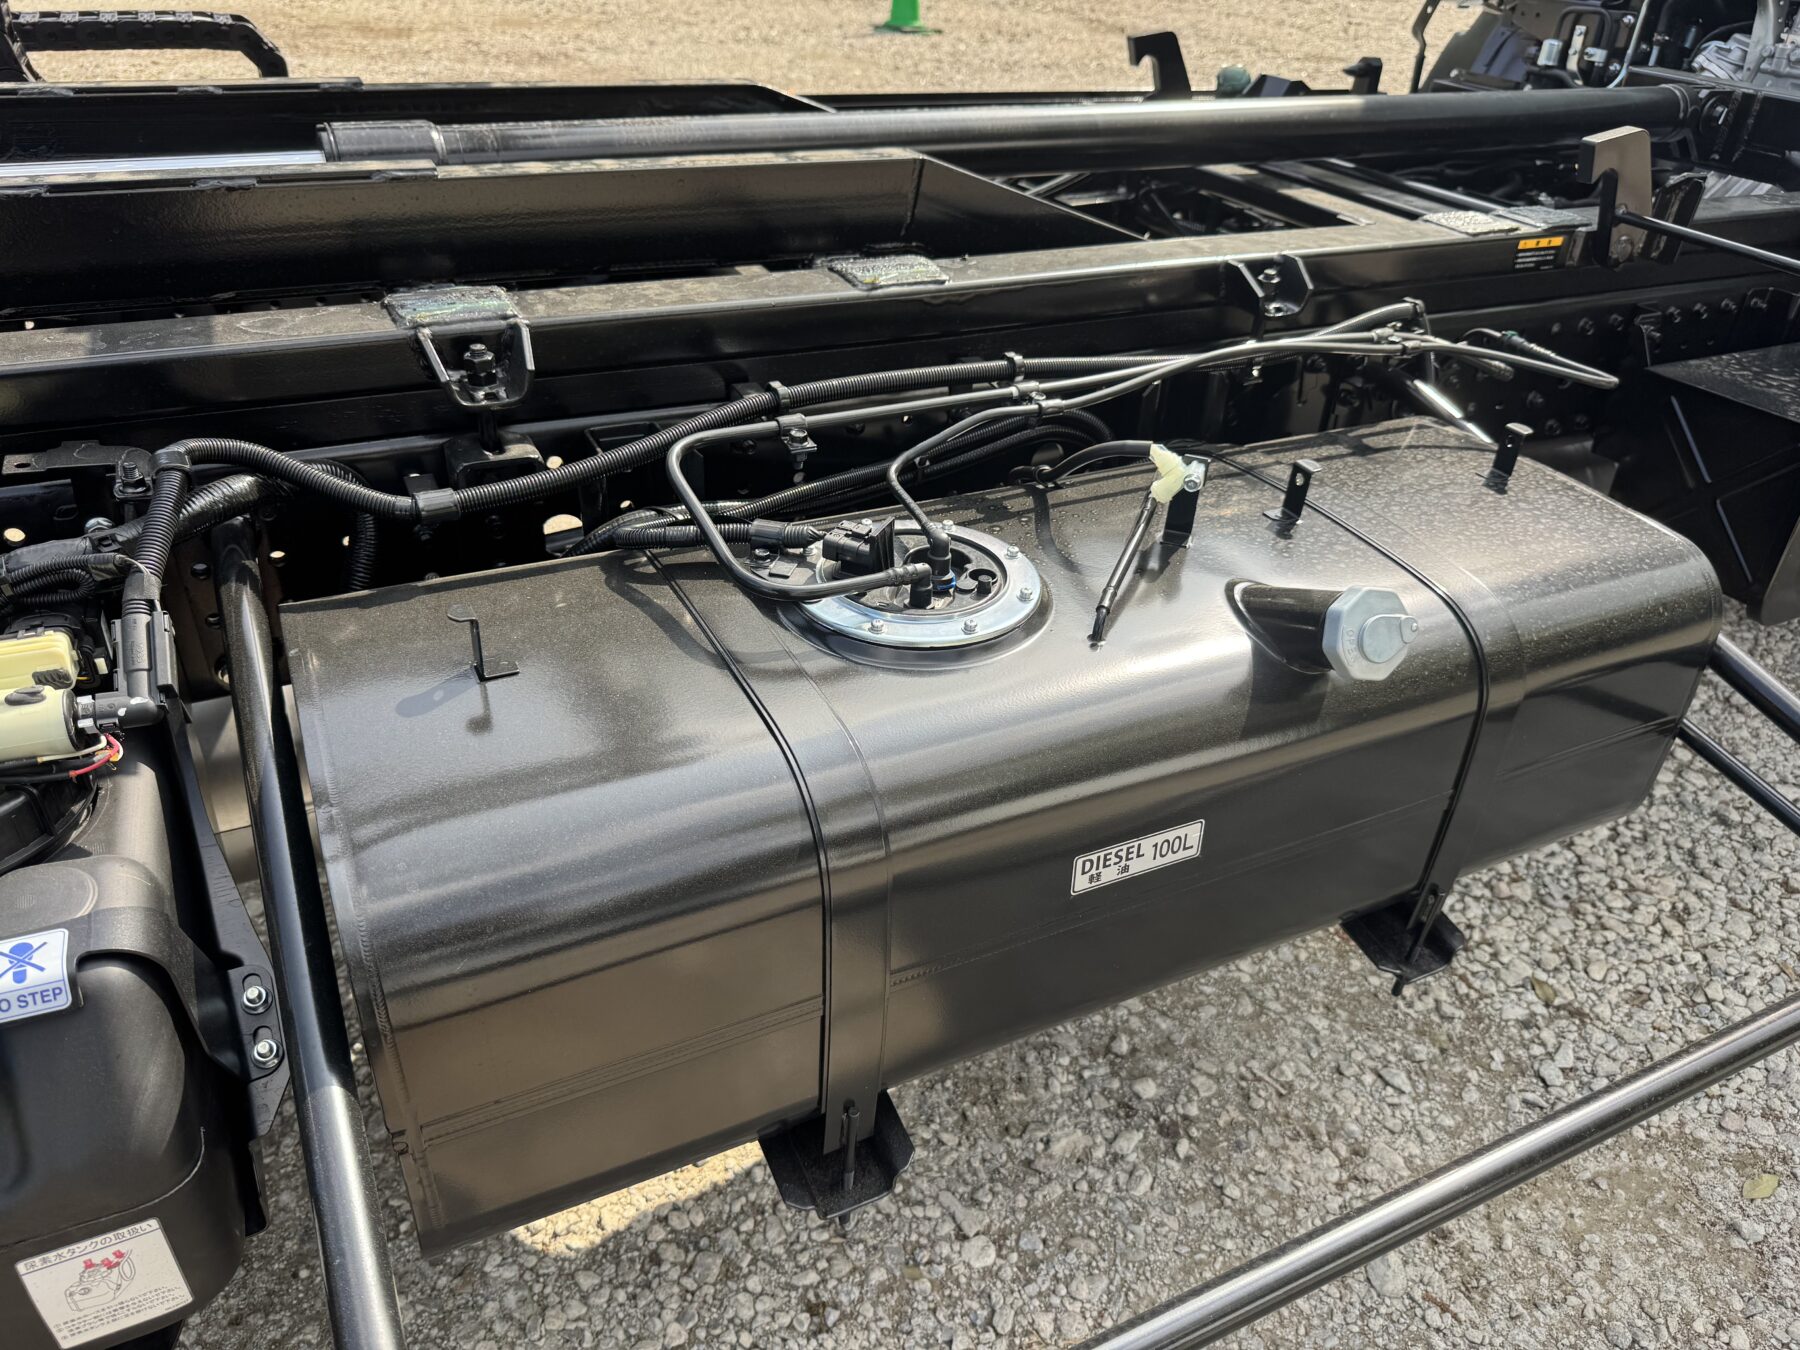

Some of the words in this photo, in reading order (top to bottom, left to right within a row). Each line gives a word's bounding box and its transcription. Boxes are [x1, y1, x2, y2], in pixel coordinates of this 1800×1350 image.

[1081, 842, 1144, 875] DIESEL
[1152, 833, 1193, 860] 100L
[17, 987, 63, 1008] STEP
[24, 1223, 153, 1271] 尿素水タンクの取扱い
